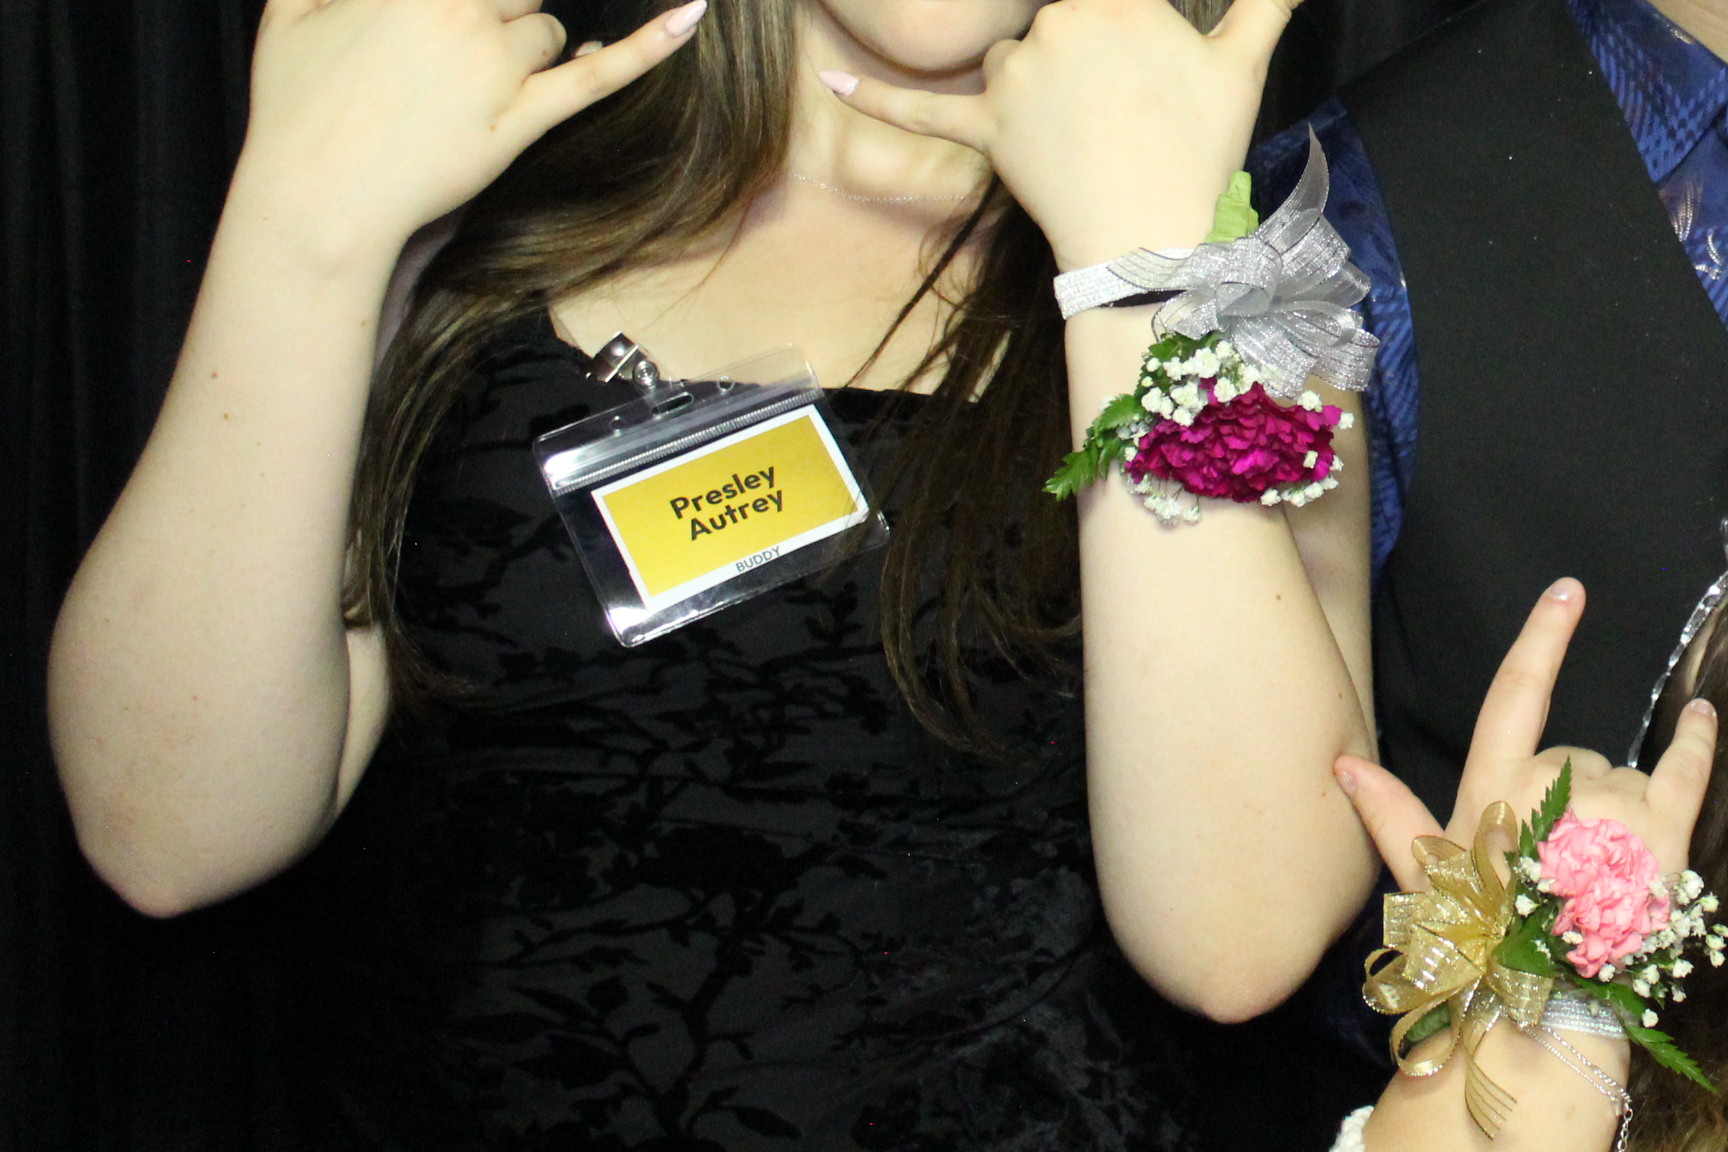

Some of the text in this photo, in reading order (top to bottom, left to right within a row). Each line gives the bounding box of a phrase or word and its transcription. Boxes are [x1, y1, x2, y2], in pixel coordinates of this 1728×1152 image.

[670, 466, 774, 519] Presley
[691, 490, 782, 541] Autrey
[735, 546, 781, 572] BUDDY
